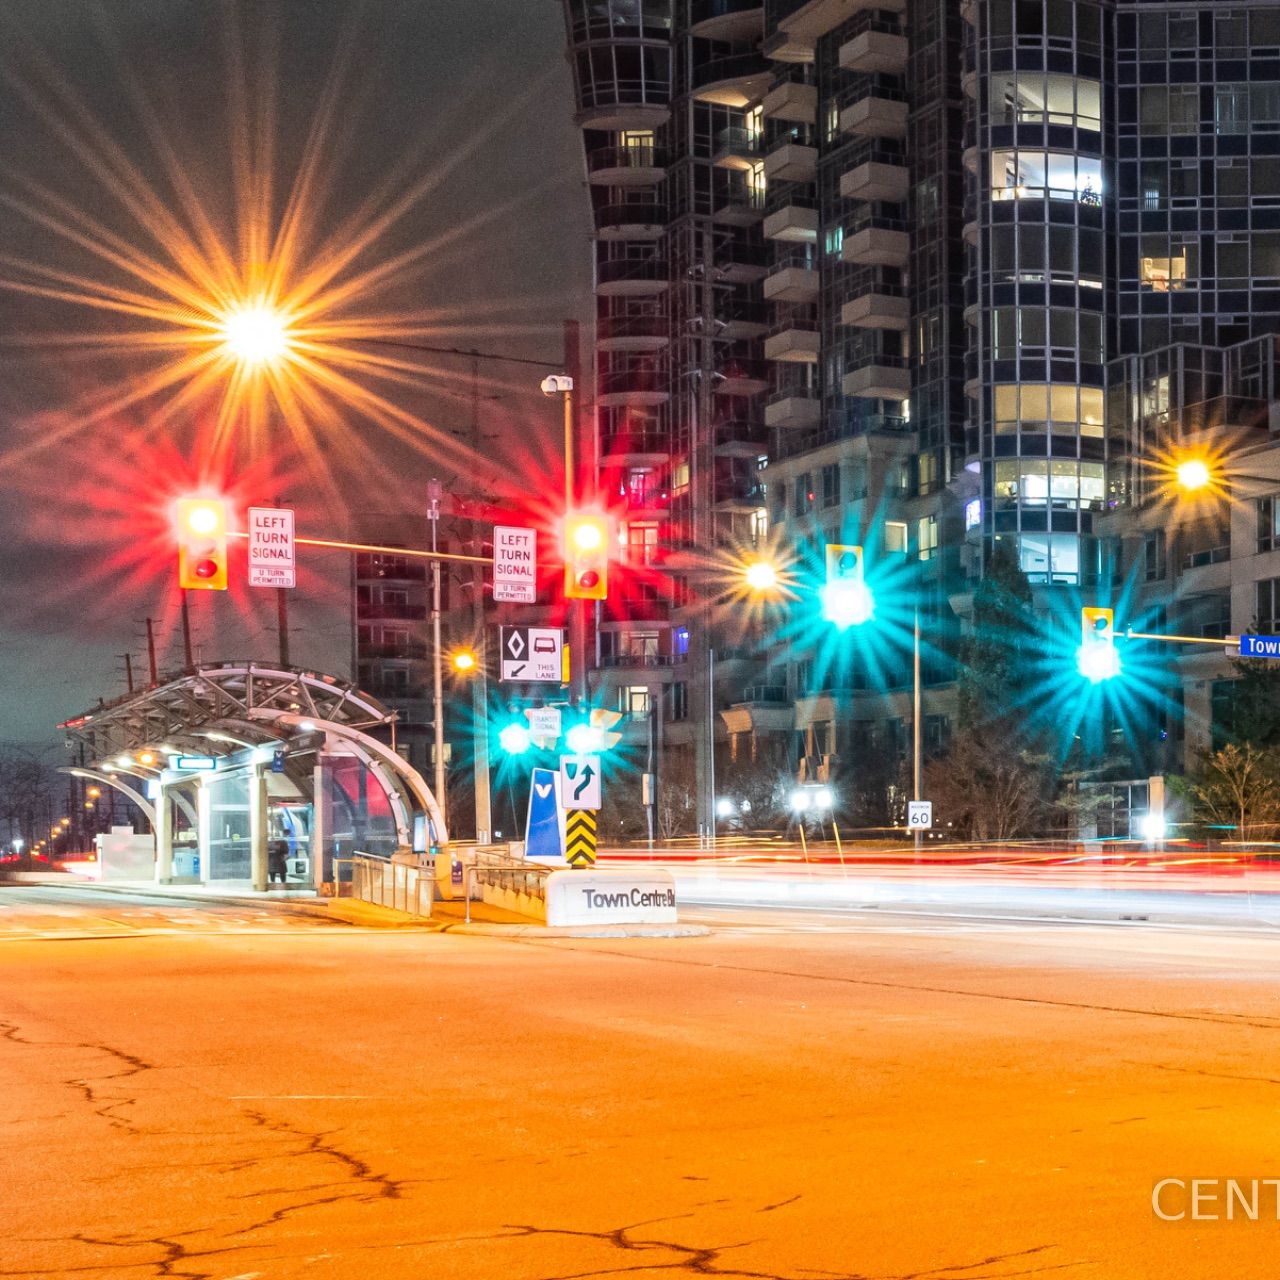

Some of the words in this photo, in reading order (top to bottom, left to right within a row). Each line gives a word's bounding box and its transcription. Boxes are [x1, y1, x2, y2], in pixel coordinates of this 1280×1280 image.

[255, 516, 285, 528] LEFT
[255, 532, 288, 543] TURN
[501, 535, 528, 546] LEFT
[252, 548, 291, 559] SIGNAL
[500, 549, 530, 560] TURN
[497, 564, 532, 576] SIGNAL
[911, 812, 929, 824] 60
[582, 889, 629, 908] Town
[631, 888, 667, 907] Centre
